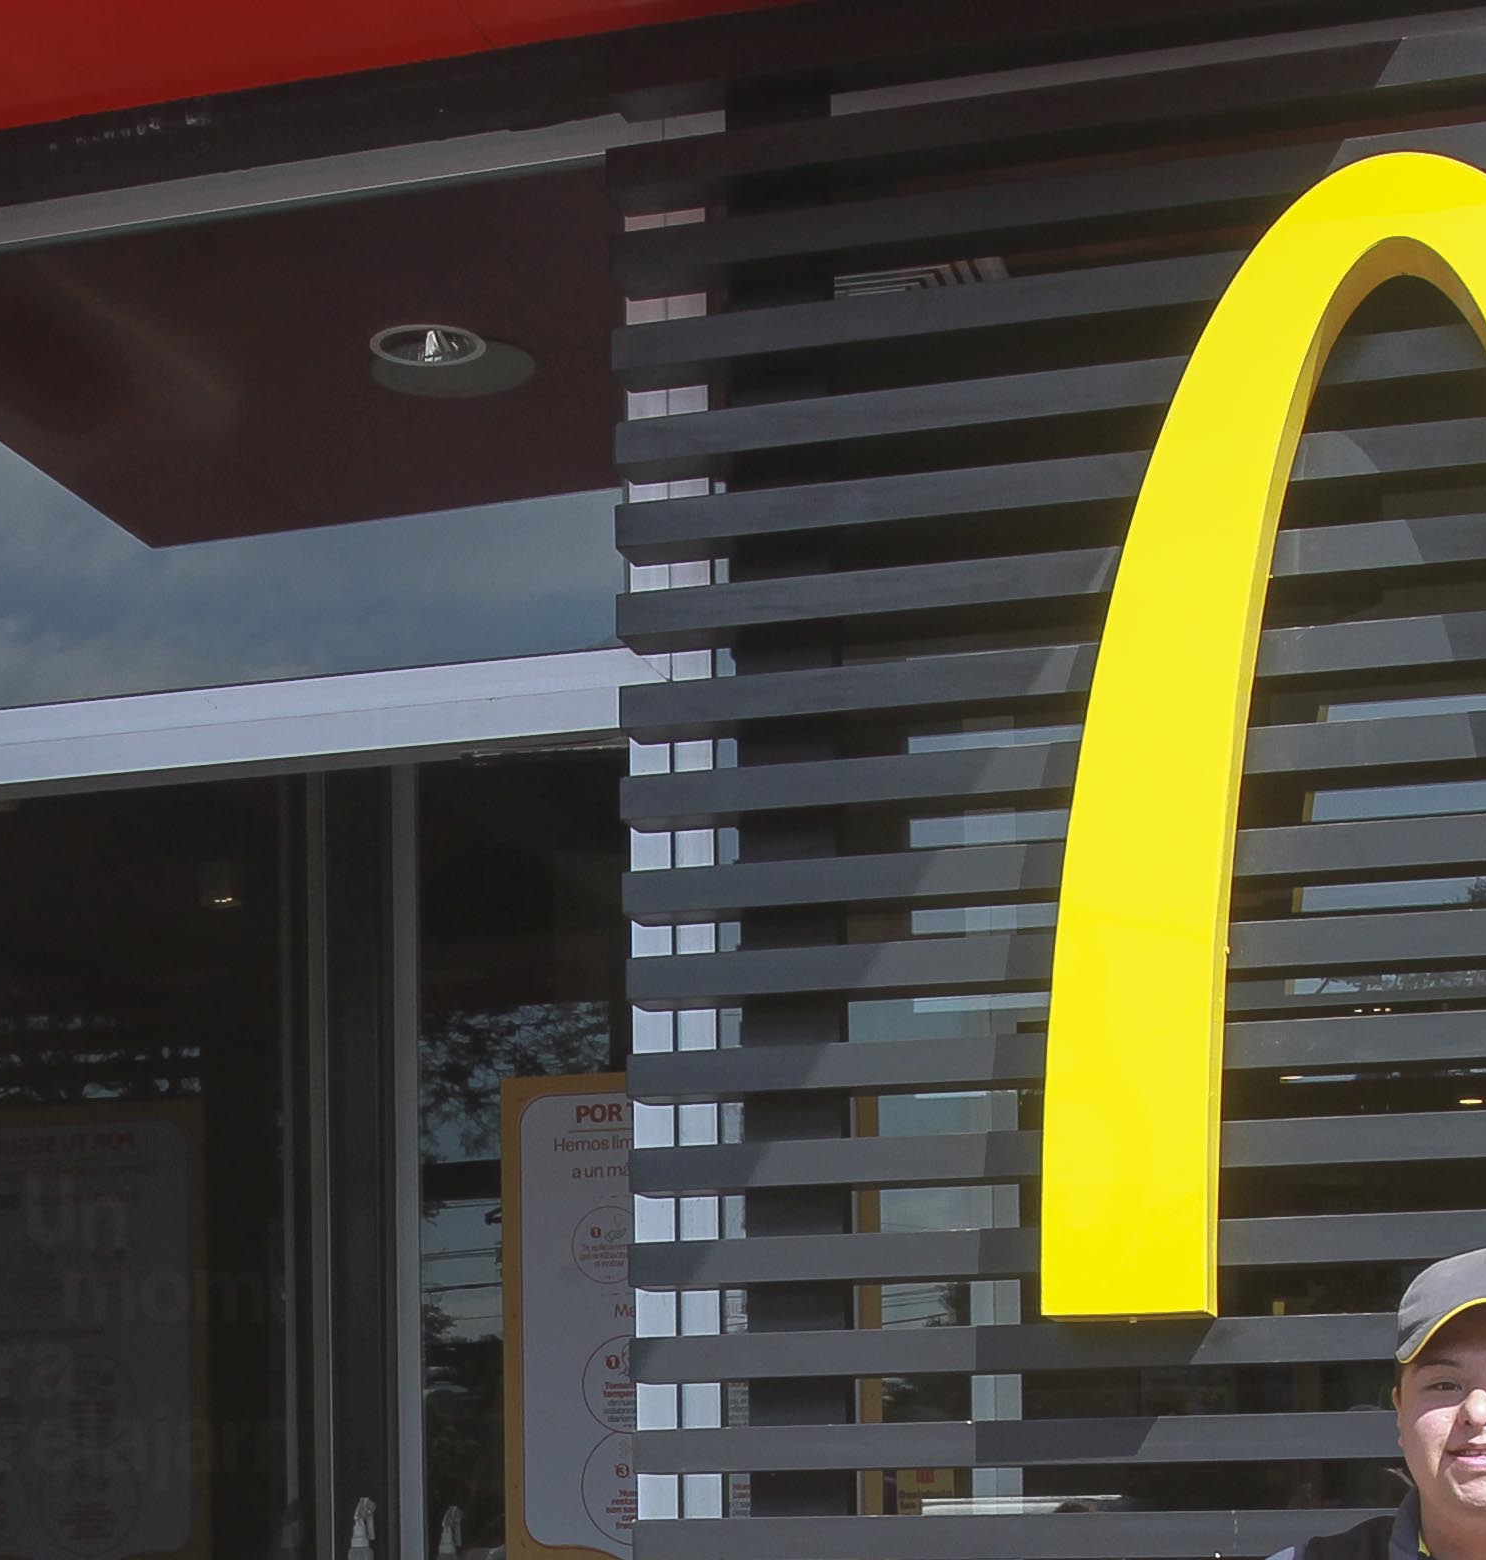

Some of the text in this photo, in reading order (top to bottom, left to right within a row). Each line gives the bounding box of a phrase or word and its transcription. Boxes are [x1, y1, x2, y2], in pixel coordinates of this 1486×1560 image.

[575, 1103, 624, 1124] POR
[553, 1136, 610, 1152] Hemos
[572, 1167, 582, 1179] a
[584, 1165, 604, 1178] un
